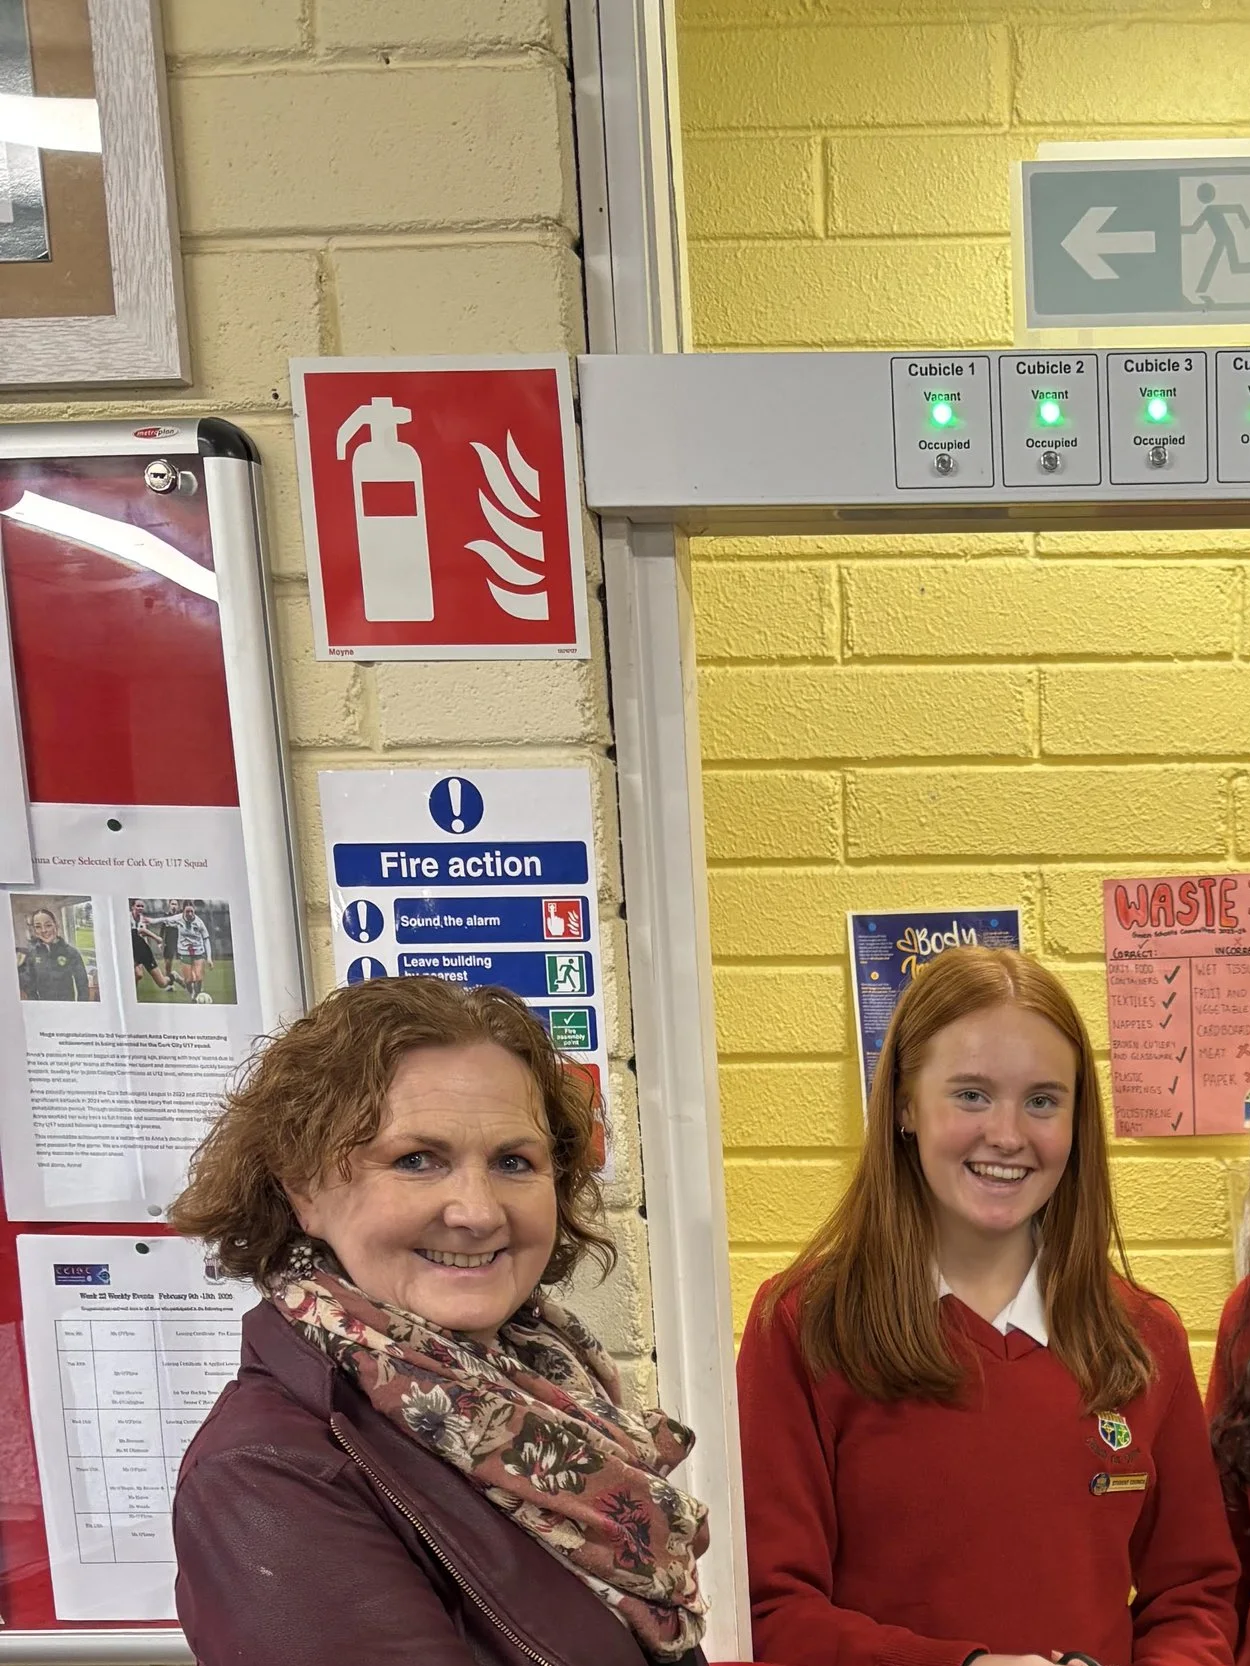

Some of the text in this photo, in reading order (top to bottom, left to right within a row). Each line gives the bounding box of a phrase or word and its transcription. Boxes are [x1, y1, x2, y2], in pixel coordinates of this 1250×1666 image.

[908, 362, 976, 377] Cubicle 1
[1016, 360, 1085, 375] Cubicle 2
[1124, 358, 1194, 372] Cubicle 3
[924, 391, 961, 402] Vacant
[1031, 389, 1069, 400] Vacant
[1139, 387, 1177, 397] Vacant
[918, 439, 971, 451] Occupied
[1026, 437, 1078, 449] Occupied
[1133, 435, 1186, 447] Occupied
[328, 648, 355, 657] Moyne
[52, 857, 76, 866] Carey
[78, 857, 111, 866] Selected
[113, 858, 124, 866] for
[127, 858, 147, 867] Cork
[149, 858, 164, 868] City
[166, 858, 182, 867] U17
[184, 859, 208, 869] Squad
[380, 850, 543, 878] Fire action
[400, 915, 500, 927] Sound the alarm
[1112, 948, 1158, 959] CORRECT:
[403, 955, 492, 969] Leave building
[1195, 964, 1217, 975] WET
[1111, 995, 1156, 1008] TEXTILES
[1112, 1019, 1153, 1029] NAPPIES
[1199, 1048, 1226, 1059] MEAT
[1203, 1073, 1238, 1087] PAPER
[158, 1292, 187, 1301] February
